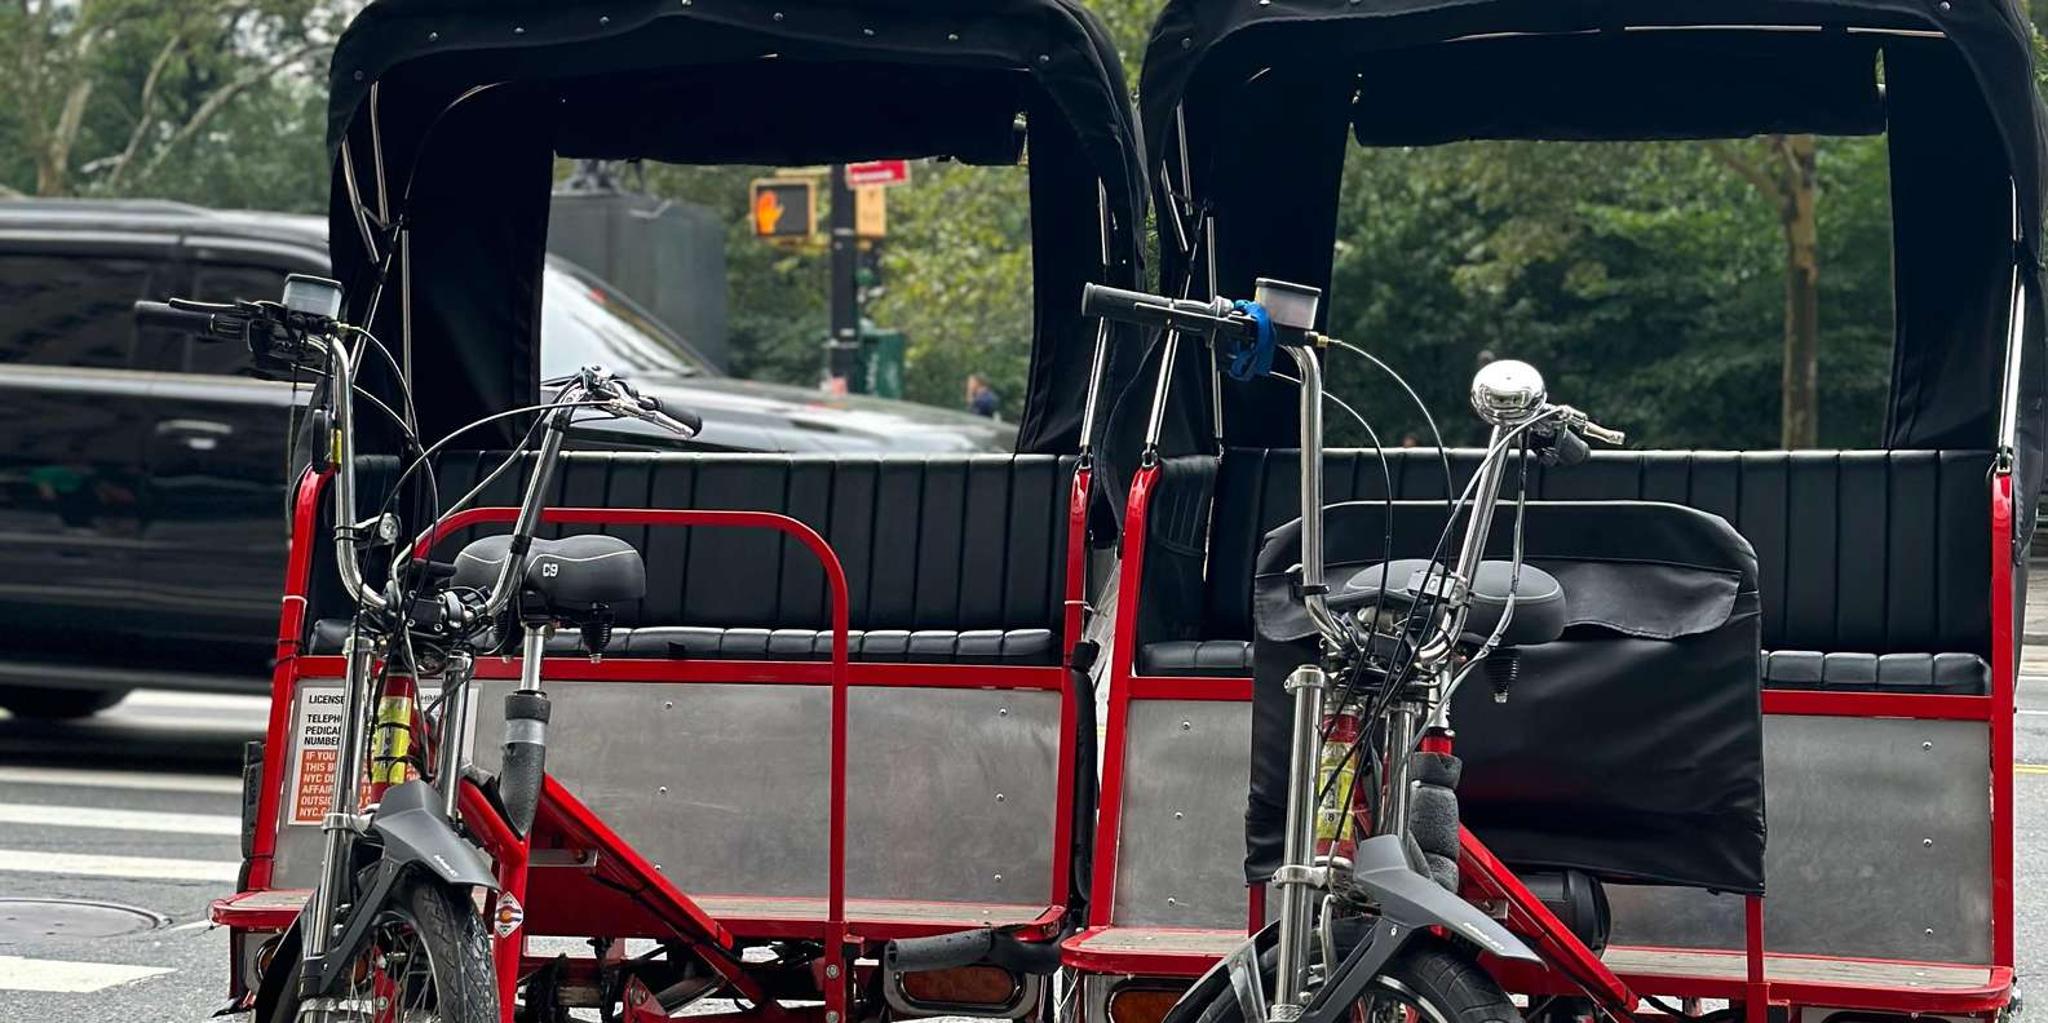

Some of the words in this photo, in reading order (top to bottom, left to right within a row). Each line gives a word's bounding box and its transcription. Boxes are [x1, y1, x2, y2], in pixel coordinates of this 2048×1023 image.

[307, 713, 342, 723] TELEPH
[317, 751, 336, 761] YOU
[305, 763, 325, 772] THIS
[303, 774, 322, 783] NYC
